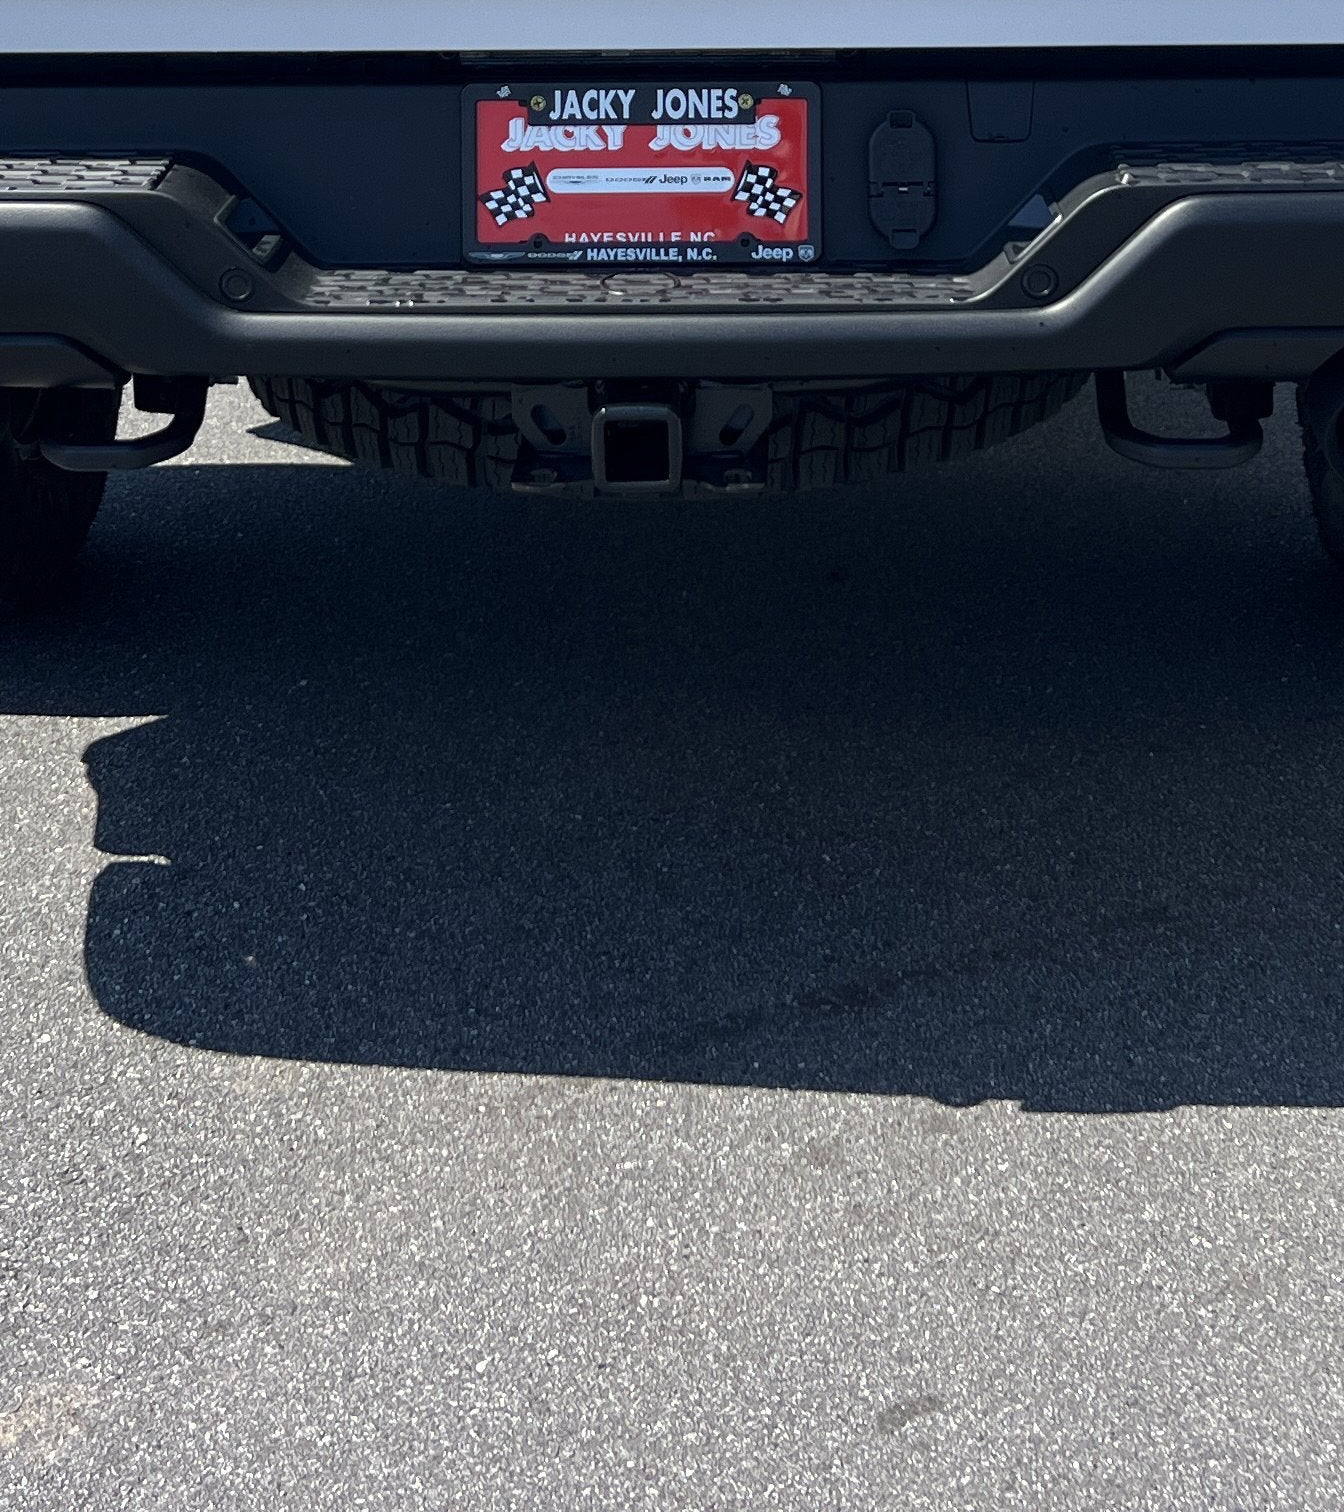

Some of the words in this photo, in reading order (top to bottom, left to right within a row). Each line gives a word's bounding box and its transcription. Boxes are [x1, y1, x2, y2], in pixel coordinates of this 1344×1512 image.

[549, 89, 636, 120] JACKY
[651, 88, 739, 120] JONES
[500, 117, 627, 152] JACKY
[648, 114, 781, 151] JONES
[659, 174, 688, 185] Jeep
[586, 248, 683, 262] HAYESVILLE,
[686, 247, 718, 261] N.C.
[751, 244, 794, 262] Jeep
